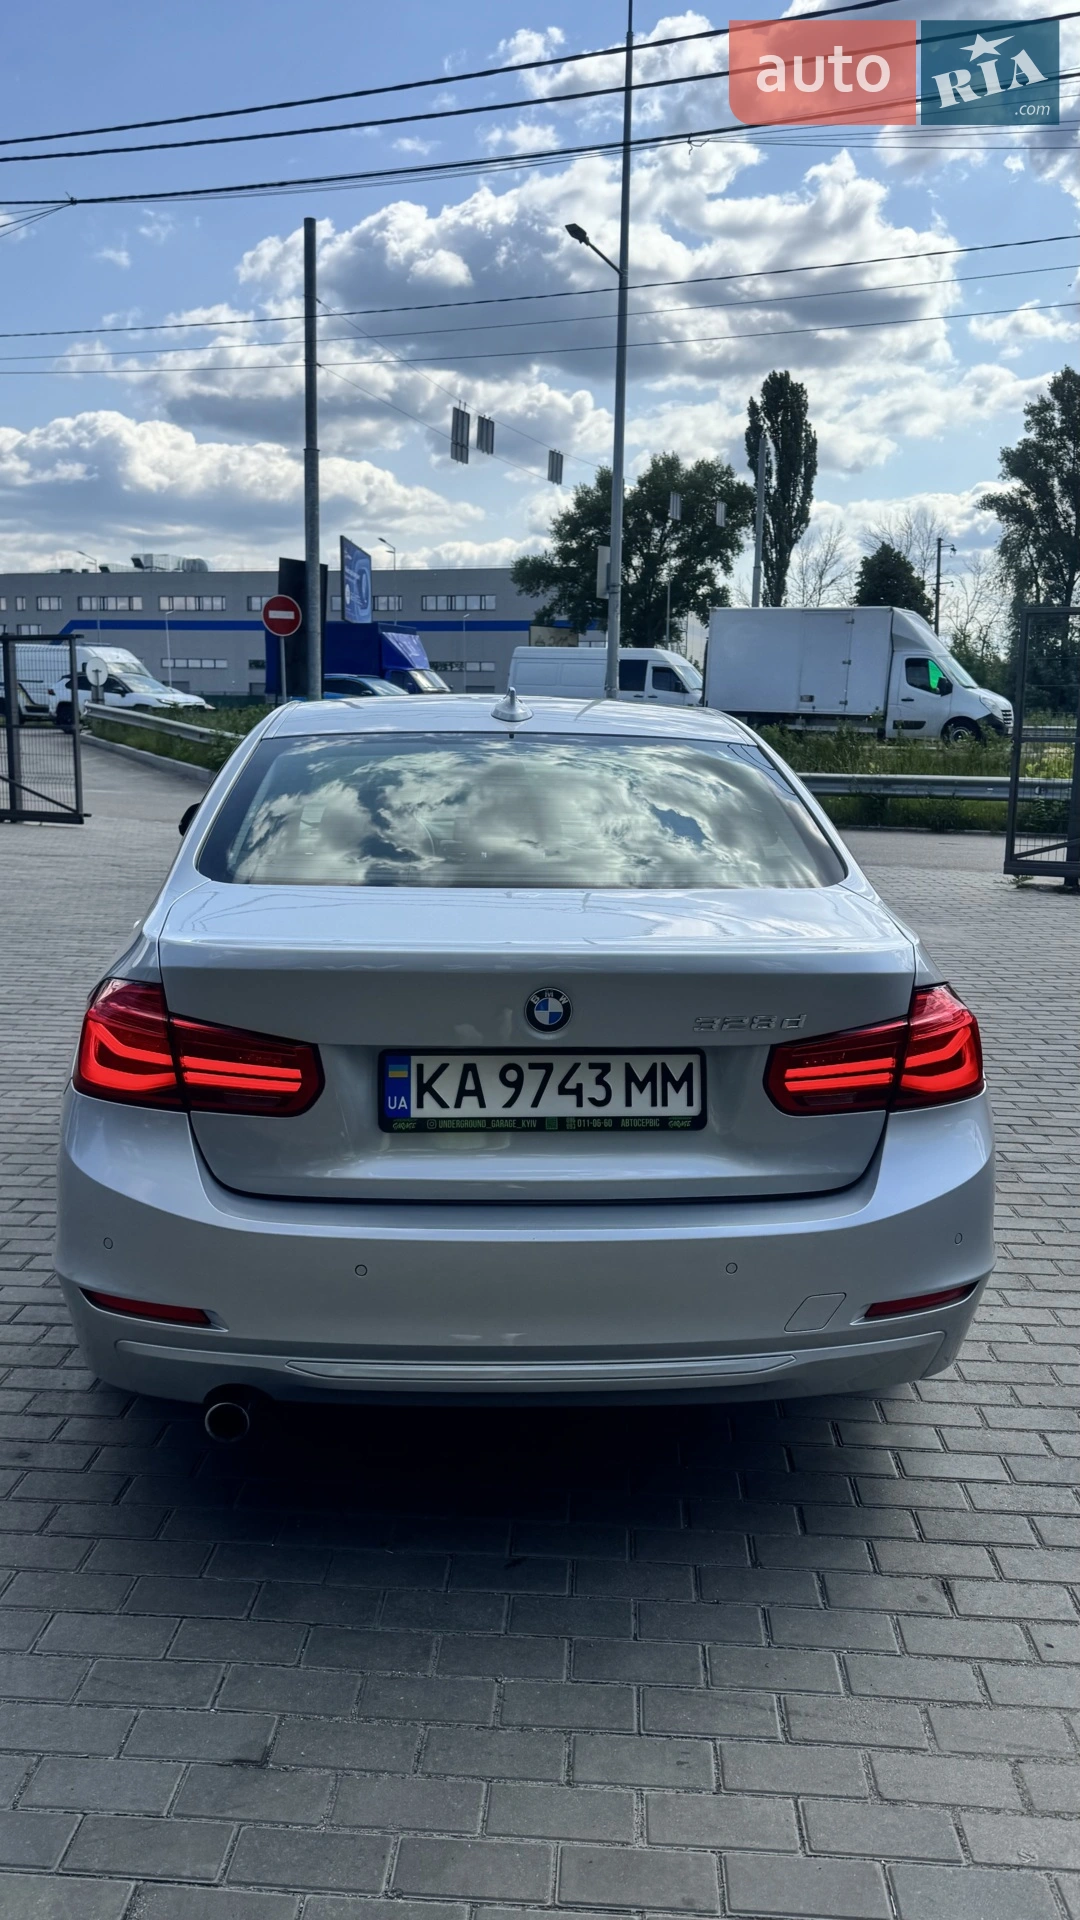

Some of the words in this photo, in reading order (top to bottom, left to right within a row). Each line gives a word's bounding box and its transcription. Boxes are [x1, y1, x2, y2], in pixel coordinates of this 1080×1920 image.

[530, 990, 569, 1005] BMW
[693, 1014, 807, 1032] 328d
[415, 1062, 487, 1109] KA
[498, 1062, 613, 1108] 9743
[624, 1062, 694, 1108] MM
[387, 1096, 408, 1110] UA
